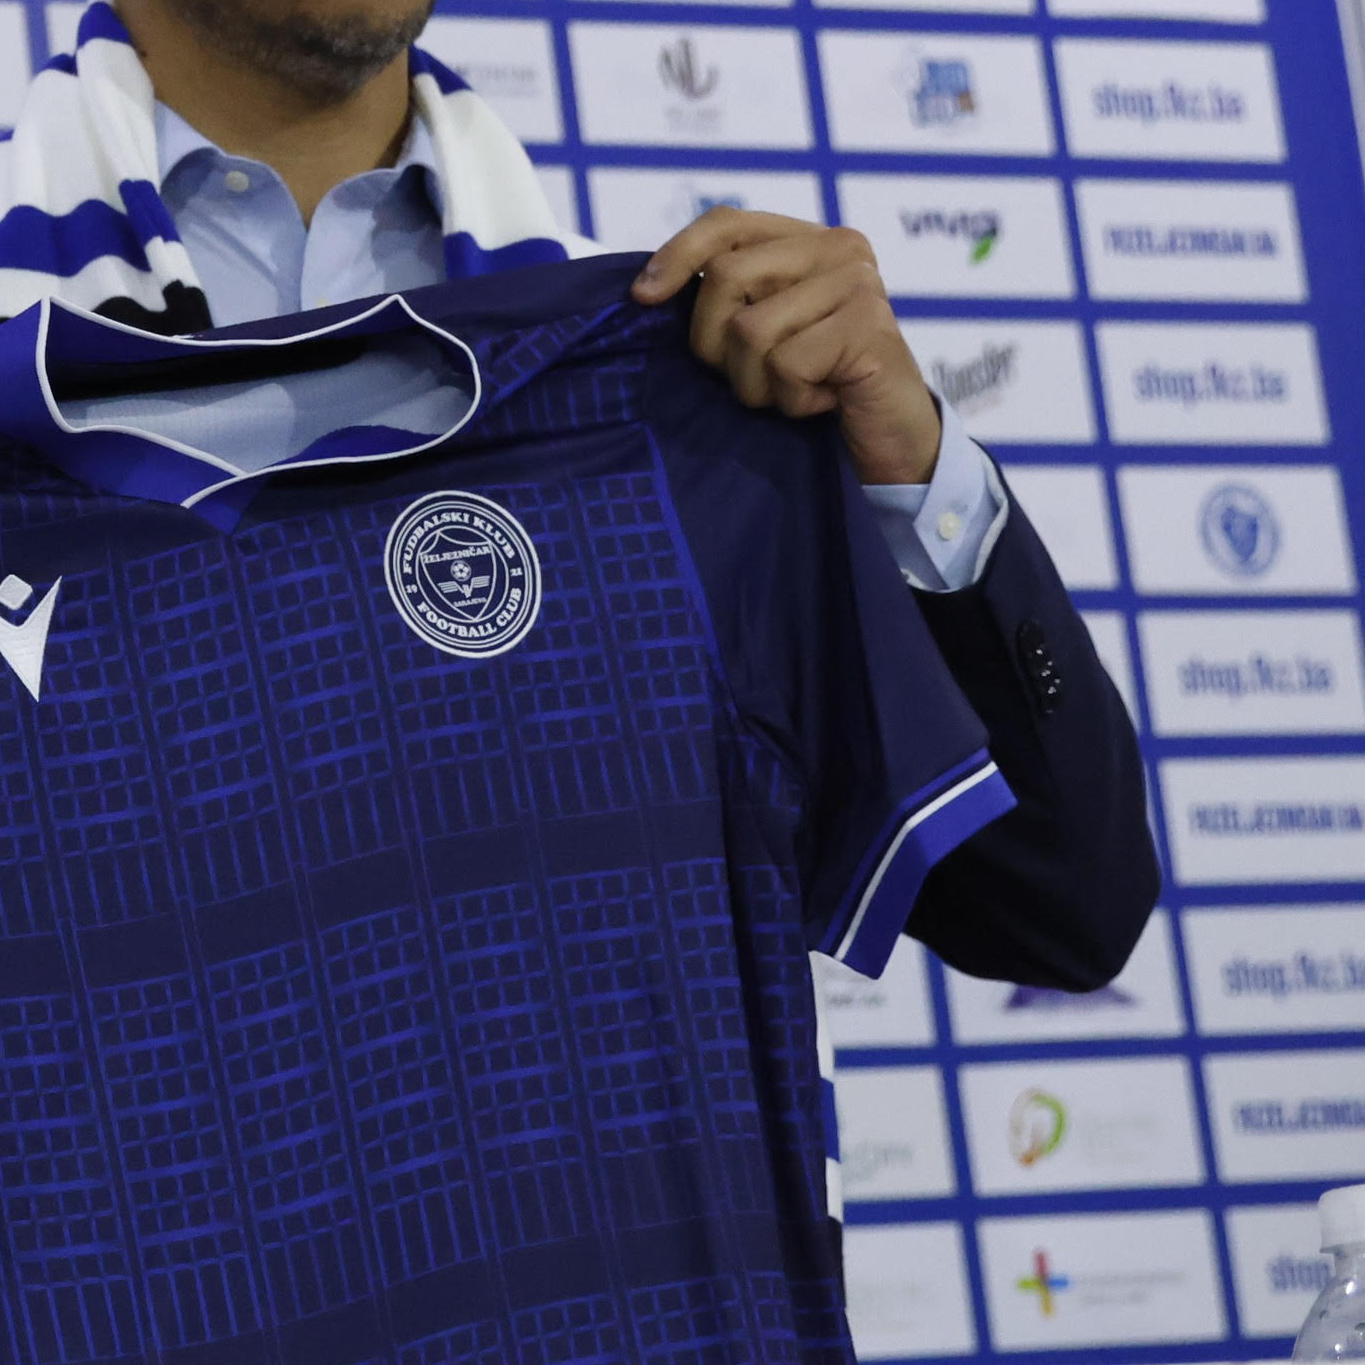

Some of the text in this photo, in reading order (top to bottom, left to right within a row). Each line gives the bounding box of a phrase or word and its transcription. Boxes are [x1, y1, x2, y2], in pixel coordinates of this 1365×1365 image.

[402, 512, 516, 574] FUDBALSKI KLUB
[422, 545, 492, 564] ŽELJEZNIČAR
[416, 587, 522, 638] FOOTBALL CLUB
